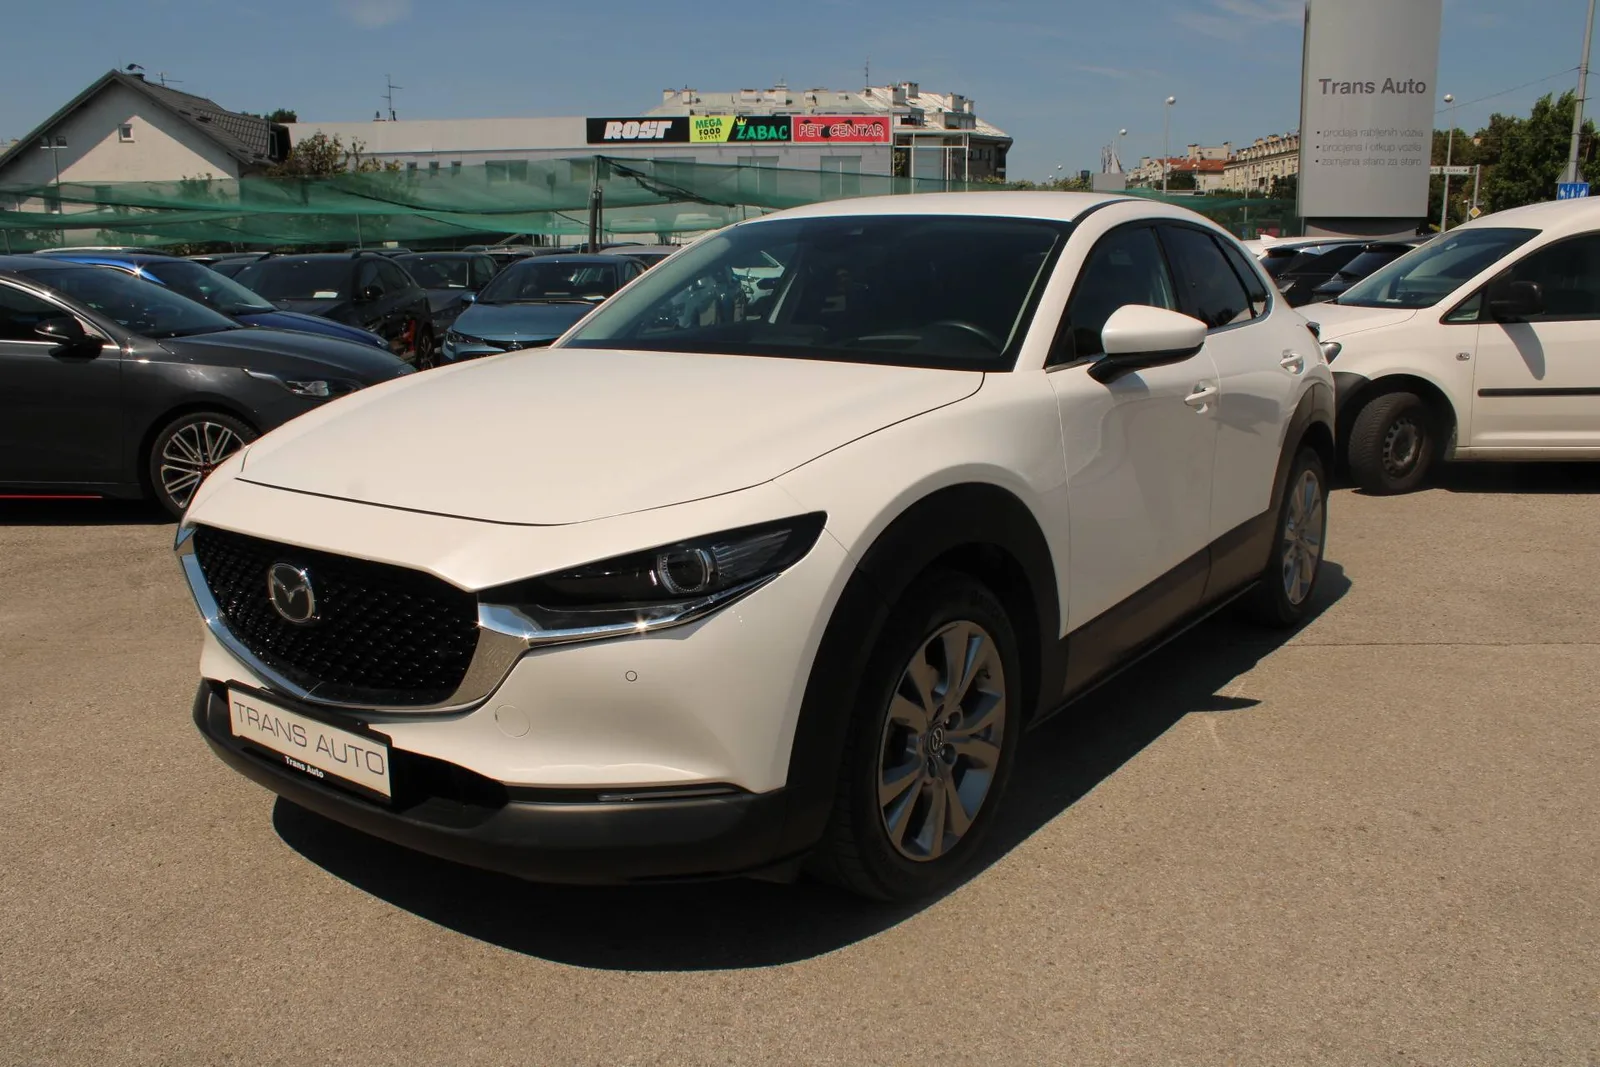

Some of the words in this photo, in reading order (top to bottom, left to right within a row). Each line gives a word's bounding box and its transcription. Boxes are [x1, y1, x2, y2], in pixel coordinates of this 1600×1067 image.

[1318, 78, 1375, 95] Trans
[1381, 77, 1427, 94] Auto
[695, 118, 722, 129] MEGA
[603, 121, 673, 140] ROST
[699, 127, 721, 136] FOOD
[799, 123, 823, 137] PET
[829, 123, 884, 137] CENTAR
[1323, 128, 1358, 139] prodaja
[1369, 143, 1395, 154] otkup
[1321, 157, 1359, 168] zamjena
[1363, 157, 1385, 166] staro
[1387, 158, 1397, 166] za
[1400, 157, 1422, 166] staro
[233, 701, 307, 747] TRANS
[316, 734, 385, 775] AUTO
[285, 755, 305, 772] Trans
[306, 764, 324, 779] Auto
